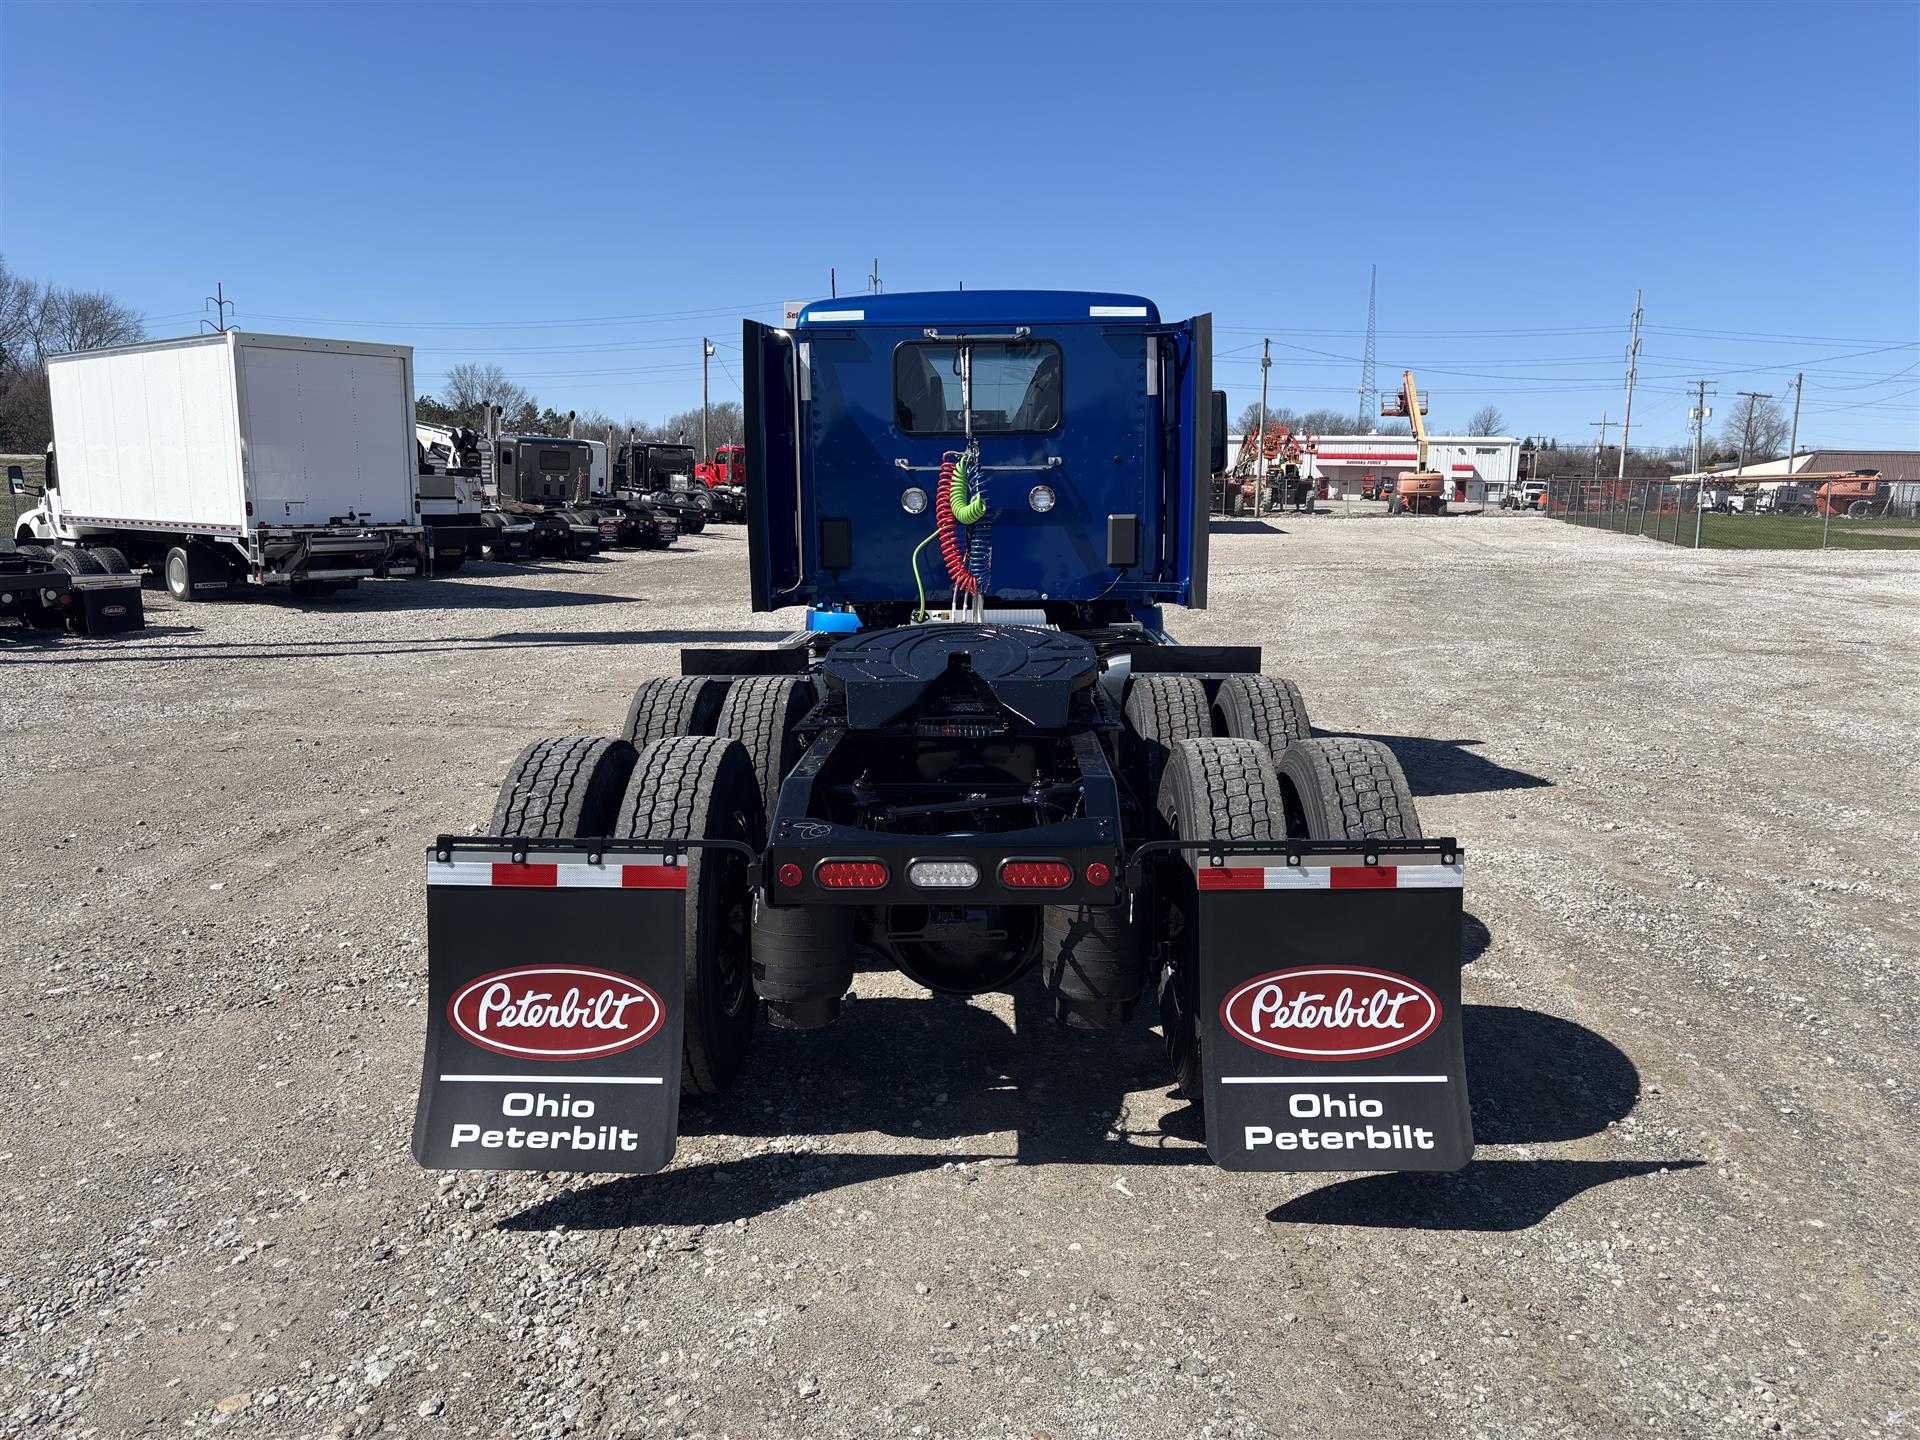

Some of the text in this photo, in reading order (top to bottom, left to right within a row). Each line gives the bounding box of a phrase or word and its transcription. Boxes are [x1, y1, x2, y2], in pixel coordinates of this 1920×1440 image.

[479, 983, 645, 1032] Peterbilt
[1251, 984, 1420, 1034] Peterbilt
[502, 1092, 595, 1118] Ohio
[1288, 1093, 1384, 1118] Ohio
[450, 1123, 639, 1152] Peterbilt
[1244, 1124, 1435, 1151] Peterbilt
